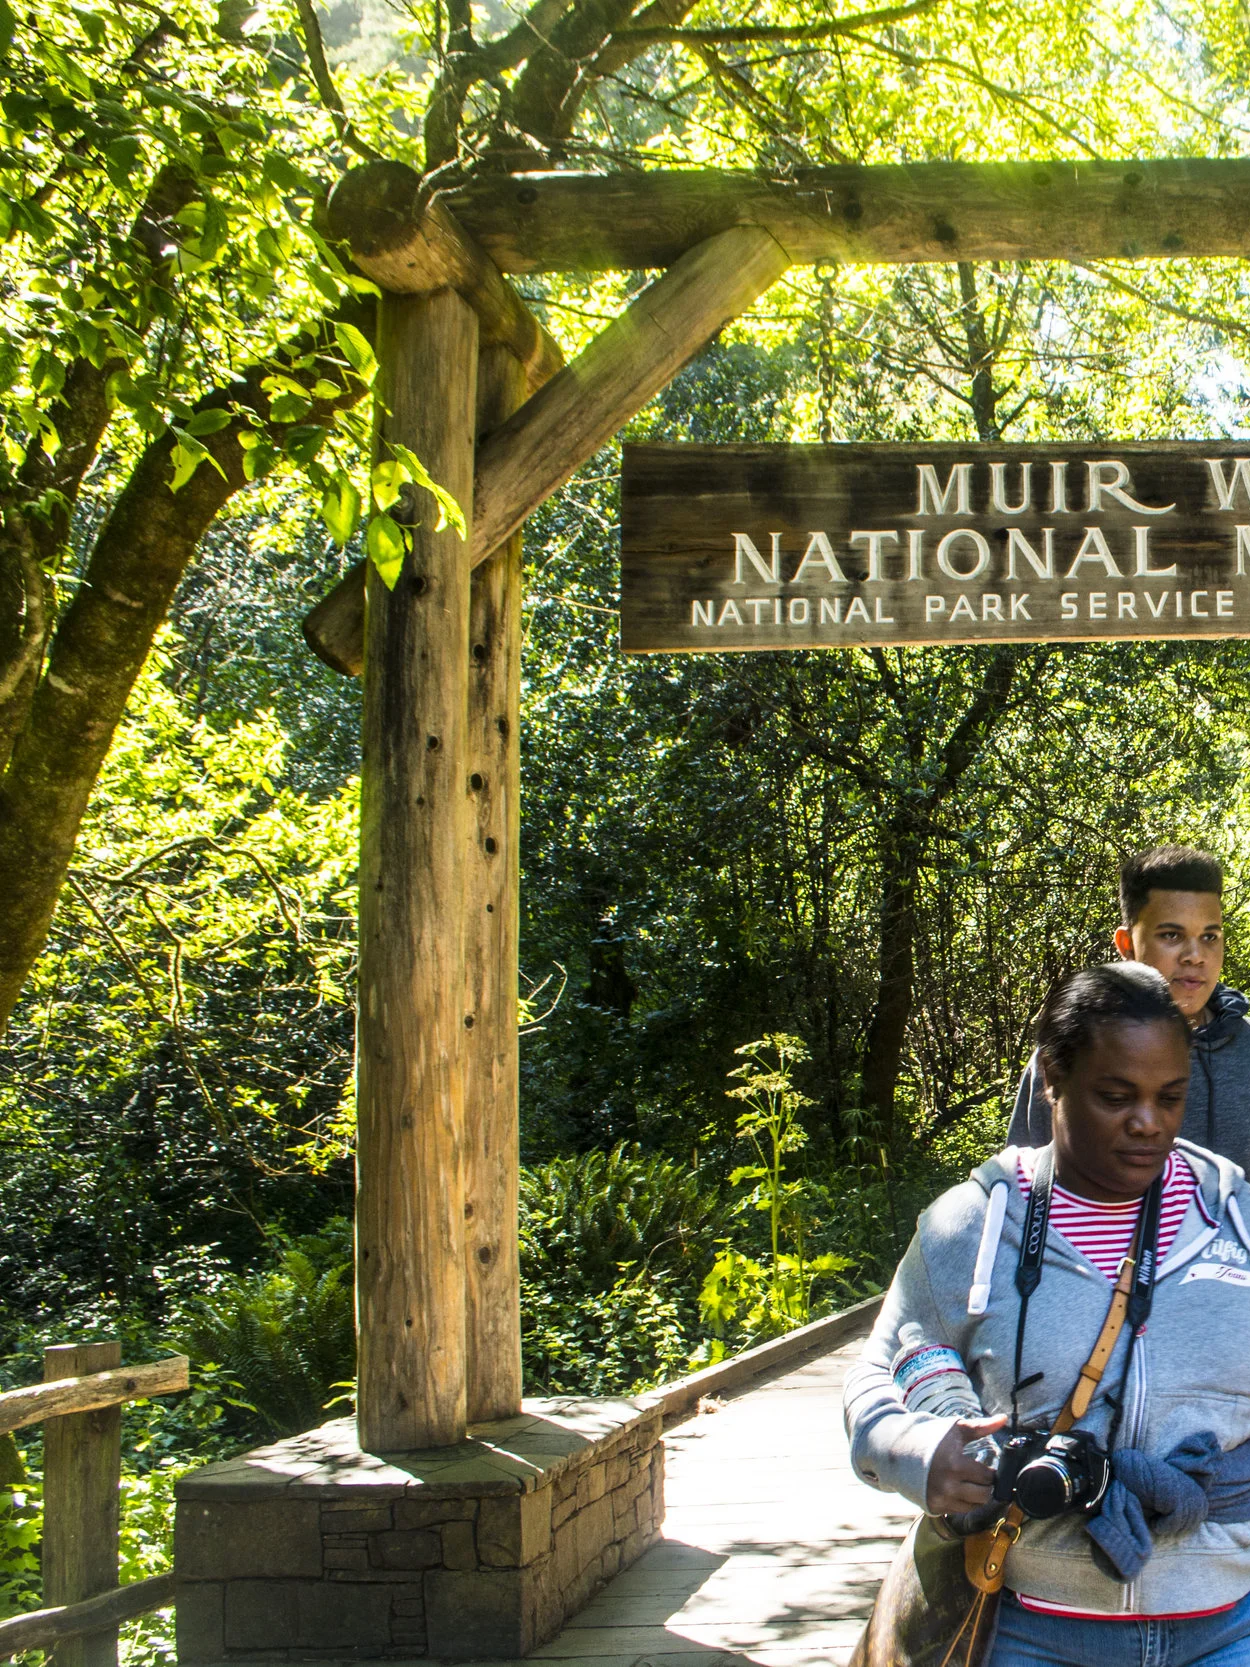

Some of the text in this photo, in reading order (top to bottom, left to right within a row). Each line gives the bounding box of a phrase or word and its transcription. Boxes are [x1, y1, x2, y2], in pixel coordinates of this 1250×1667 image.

[915, 460, 1177, 516] MUIR
[731, 526, 1178, 586] NATIONAL
[691, 596, 895, 627] NATIONAL
[925, 592, 1032, 622] PARK
[1060, 589, 1234, 620] SERVICE
[1138, 1249, 1153, 1285] Nikon
